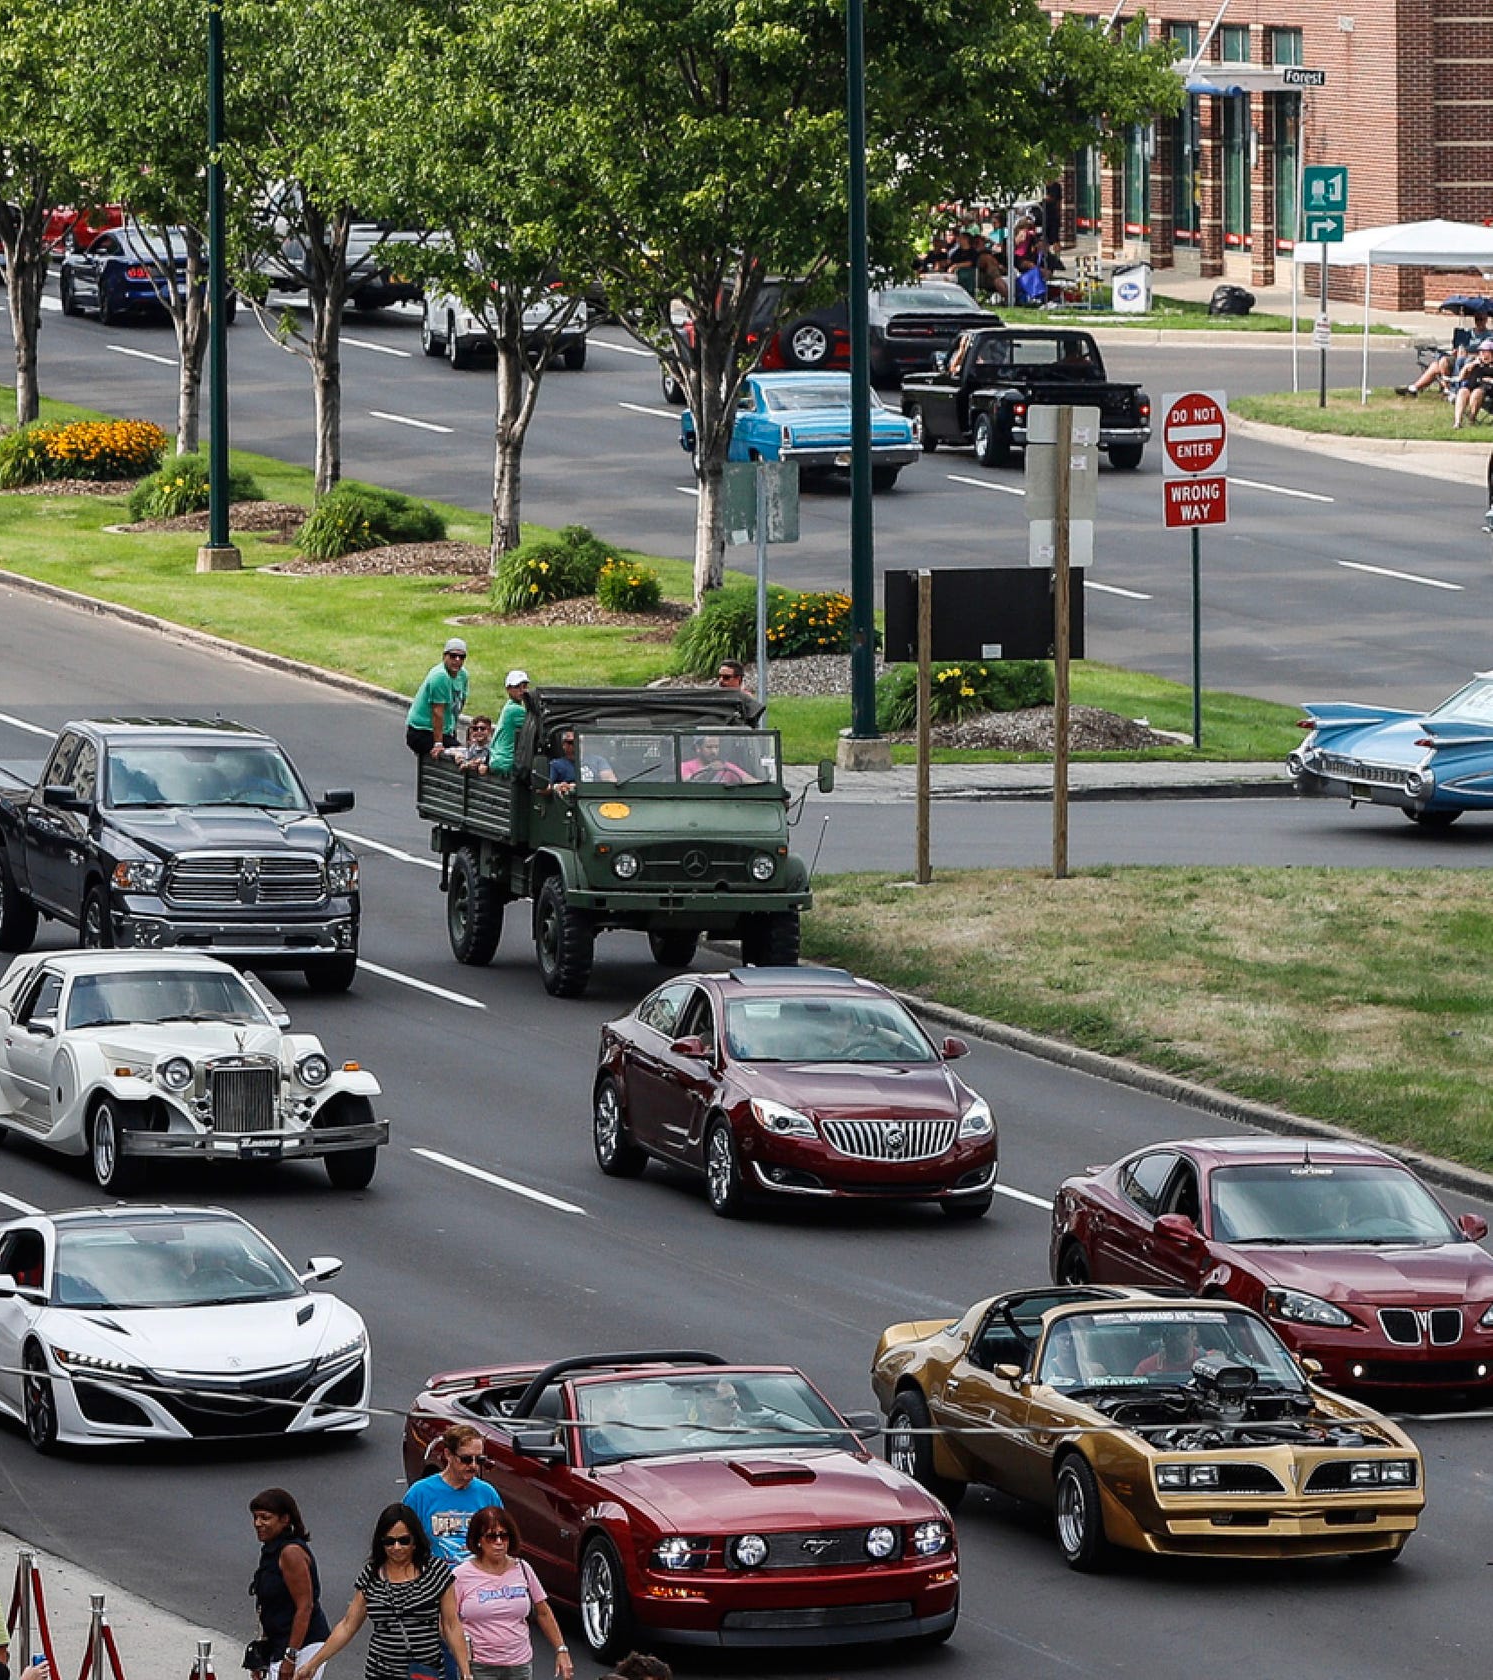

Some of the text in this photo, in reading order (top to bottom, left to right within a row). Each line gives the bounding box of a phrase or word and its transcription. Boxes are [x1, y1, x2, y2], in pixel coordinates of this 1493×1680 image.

[1286, 70, 1322, 84] Forest
[1171, 407, 1217, 424] DO NOT
[1176, 443, 1214, 458] ENTER
[1171, 483, 1221, 503] WRONG
[1180, 503, 1211, 521] WAY
